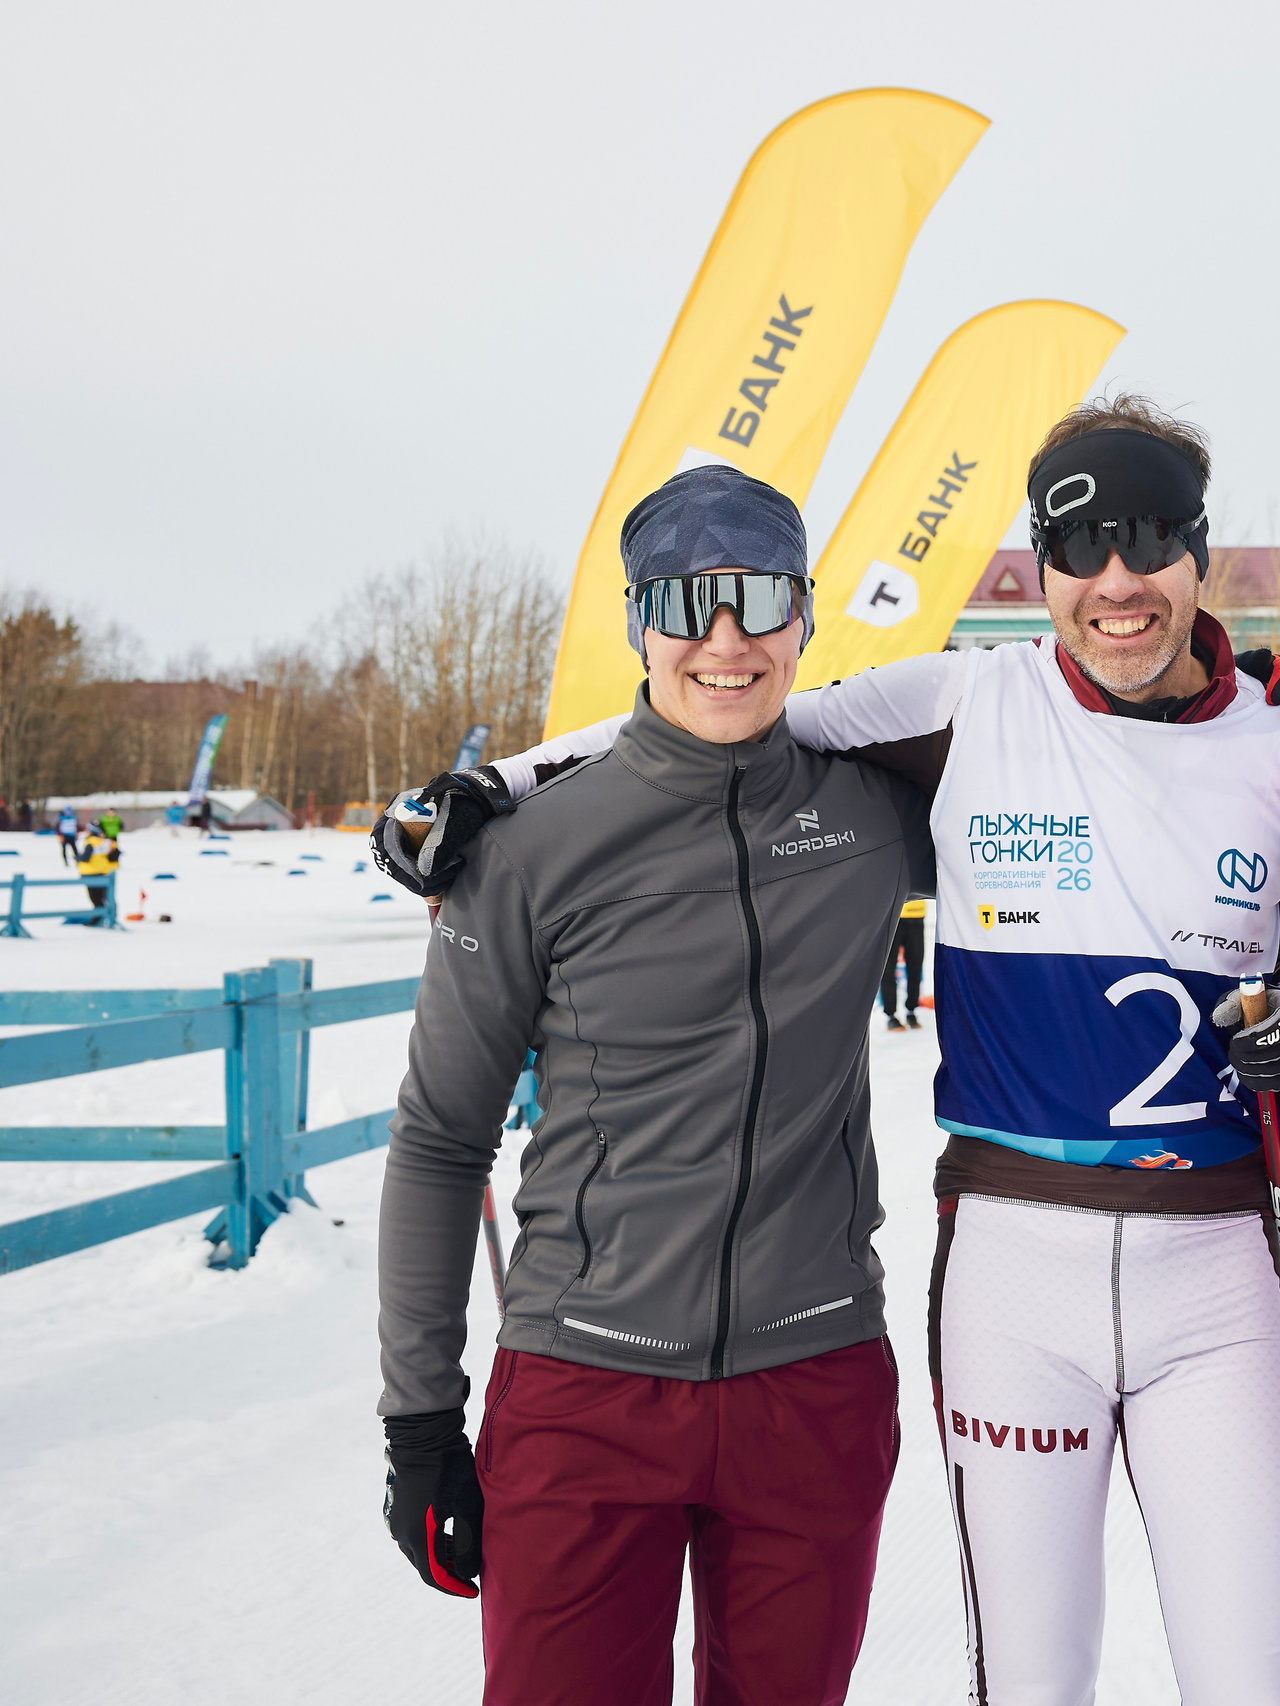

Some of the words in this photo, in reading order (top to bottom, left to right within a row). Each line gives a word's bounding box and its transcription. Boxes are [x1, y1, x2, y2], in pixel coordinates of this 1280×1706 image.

[718, 293, 814, 448] БАНК
[869, 581, 900, 607] Т
[898, 451, 978, 563] БАНК
[967, 813, 1090, 838] ЛЫЖНЫЕ
[771, 830, 856, 857] NORDSKI
[969, 840, 1054, 864] ГОНКИ
[1057, 840, 1094, 864] 20
[973, 870, 1047, 880] КОРПОРАТИВНЫЕ
[975, 880, 1042, 890] СОРЕВНОВАНИЯ
[1056, 867, 1092, 892] 26
[1214, 894, 1261, 912] НОРНИКЕЛЬ
[998, 911, 1041, 924] БАНК
[1197, 933, 1264, 954] TRAVEL
[951, 1408, 1089, 1453] BIVIUM
